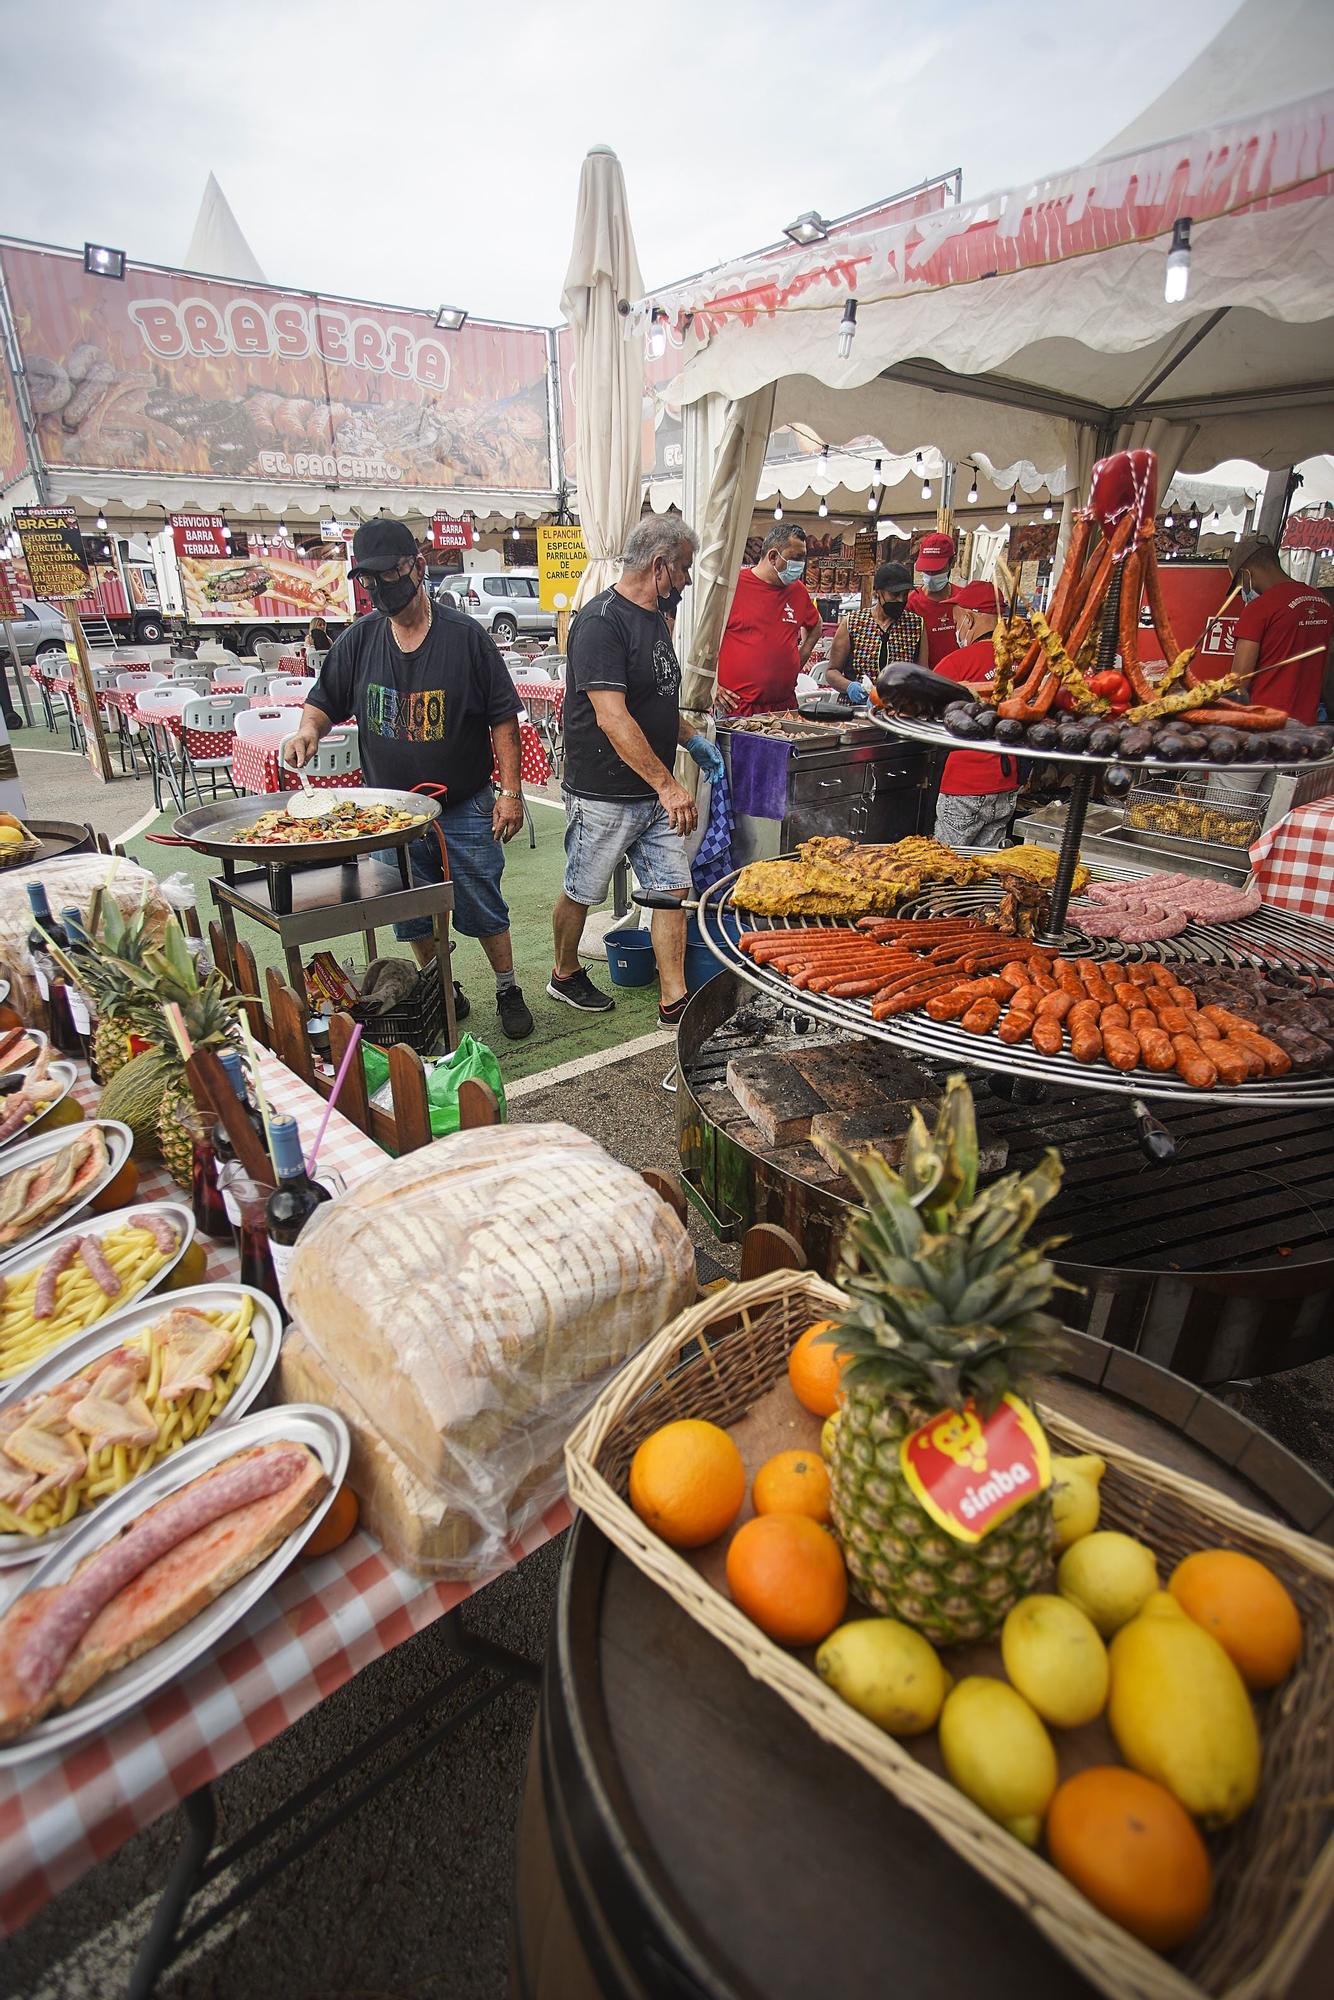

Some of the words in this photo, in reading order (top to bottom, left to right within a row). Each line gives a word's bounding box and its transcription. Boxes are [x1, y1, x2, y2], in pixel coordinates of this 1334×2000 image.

[128, 298, 450, 391] BRASERIA
[259, 451, 293, 476] EL
[293, 452, 402, 481] PANCHITO
[17, 518, 67, 529] BRASA
[172, 516, 210, 527] SERVICIO
[211, 517, 223, 527] EN
[441, 524, 463, 534] BARRA
[22, 533, 62, 542] CHORIZO
[185, 530, 214, 541] BARRA
[543, 530, 551, 539] EL
[553, 530, 581, 539] PANCHIT
[438, 535, 467, 546] TERRAZA
[25, 543, 72, 552] MORCILLA
[183, 543, 221, 555] TERRAZA
[547, 541, 586, 550] ESPECIAL
[27, 553, 81, 562] CHISTORRA
[546, 551, 587, 560] PARRILLADA
[30, 563, 74, 572] PINCHITO
[560, 561, 570, 569] DE
[33, 573, 87, 583] BUTIFARRA
[546, 571, 570, 579] CARNE
[35, 584, 79, 593] COSTILLA
[959, 1462, 1032, 1519] simba
